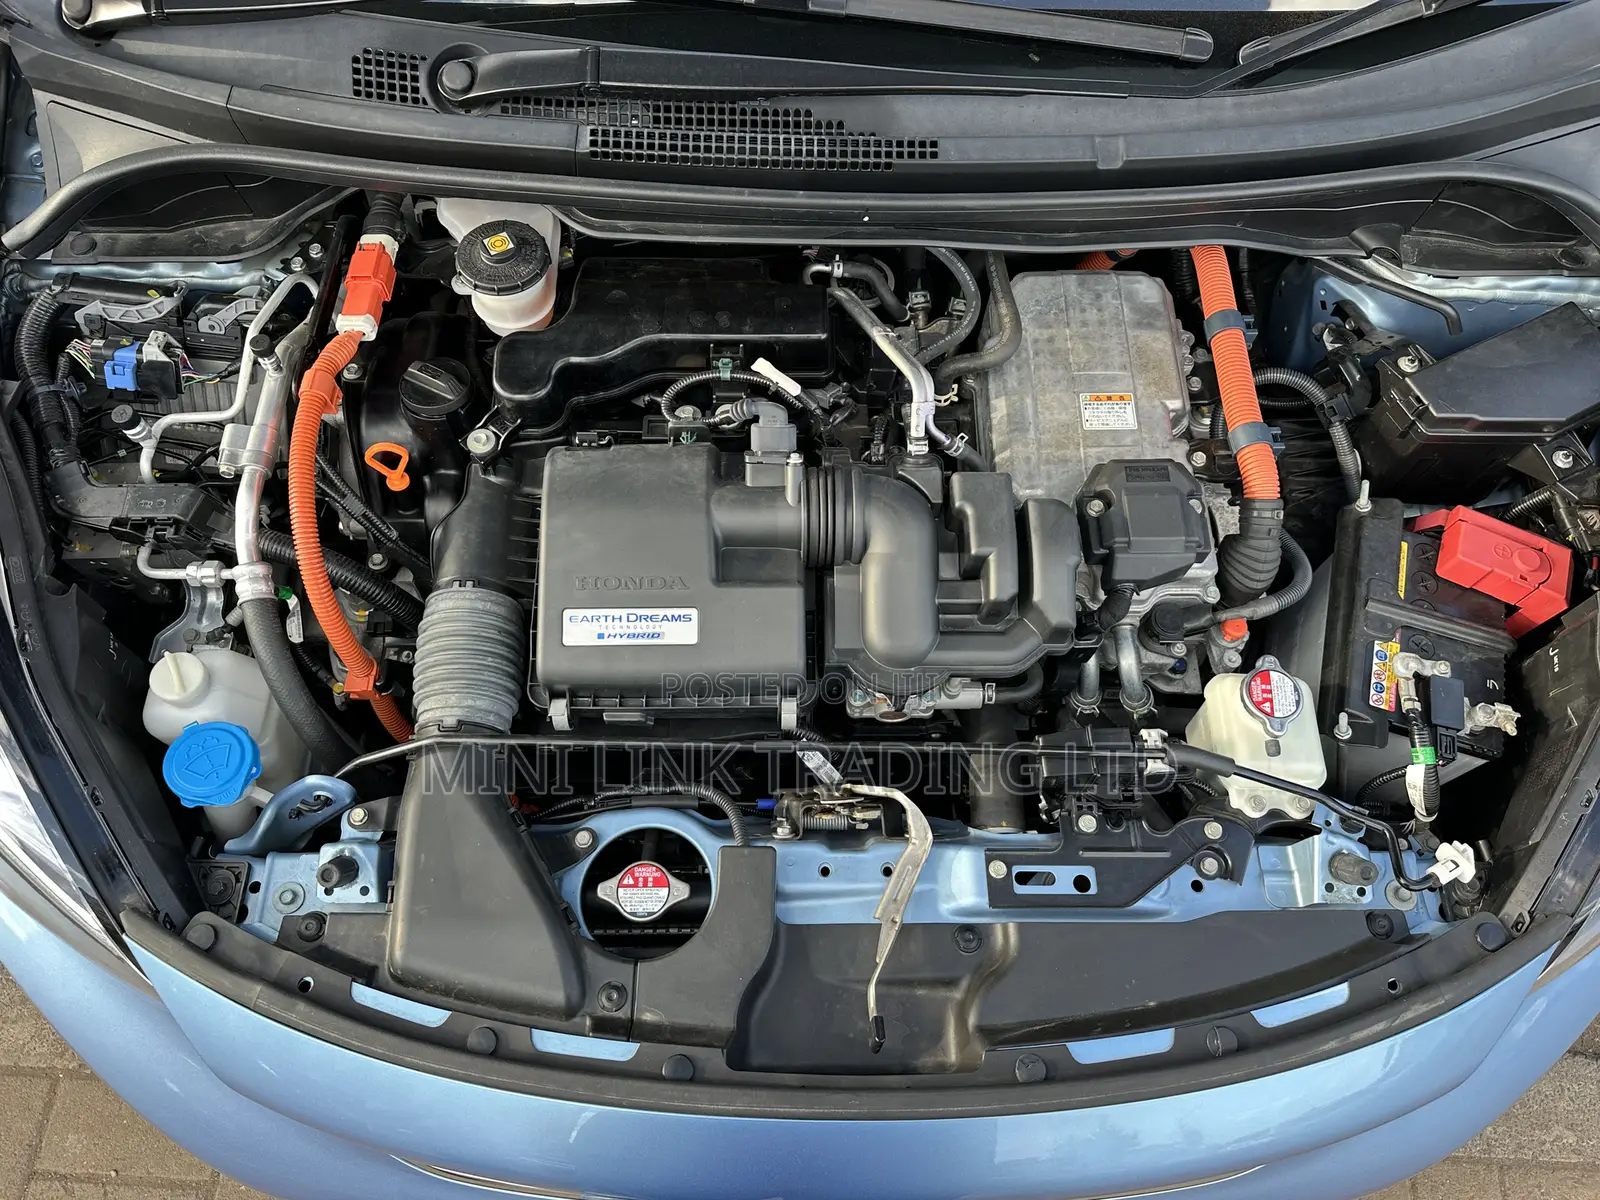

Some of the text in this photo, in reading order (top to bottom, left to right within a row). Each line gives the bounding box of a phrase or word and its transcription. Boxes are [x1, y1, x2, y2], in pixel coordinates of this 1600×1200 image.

[574, 575, 691, 591] HONDA
[569, 613, 693, 624] EARTH DREAMS
[606, 632, 661, 640] HYBRID
